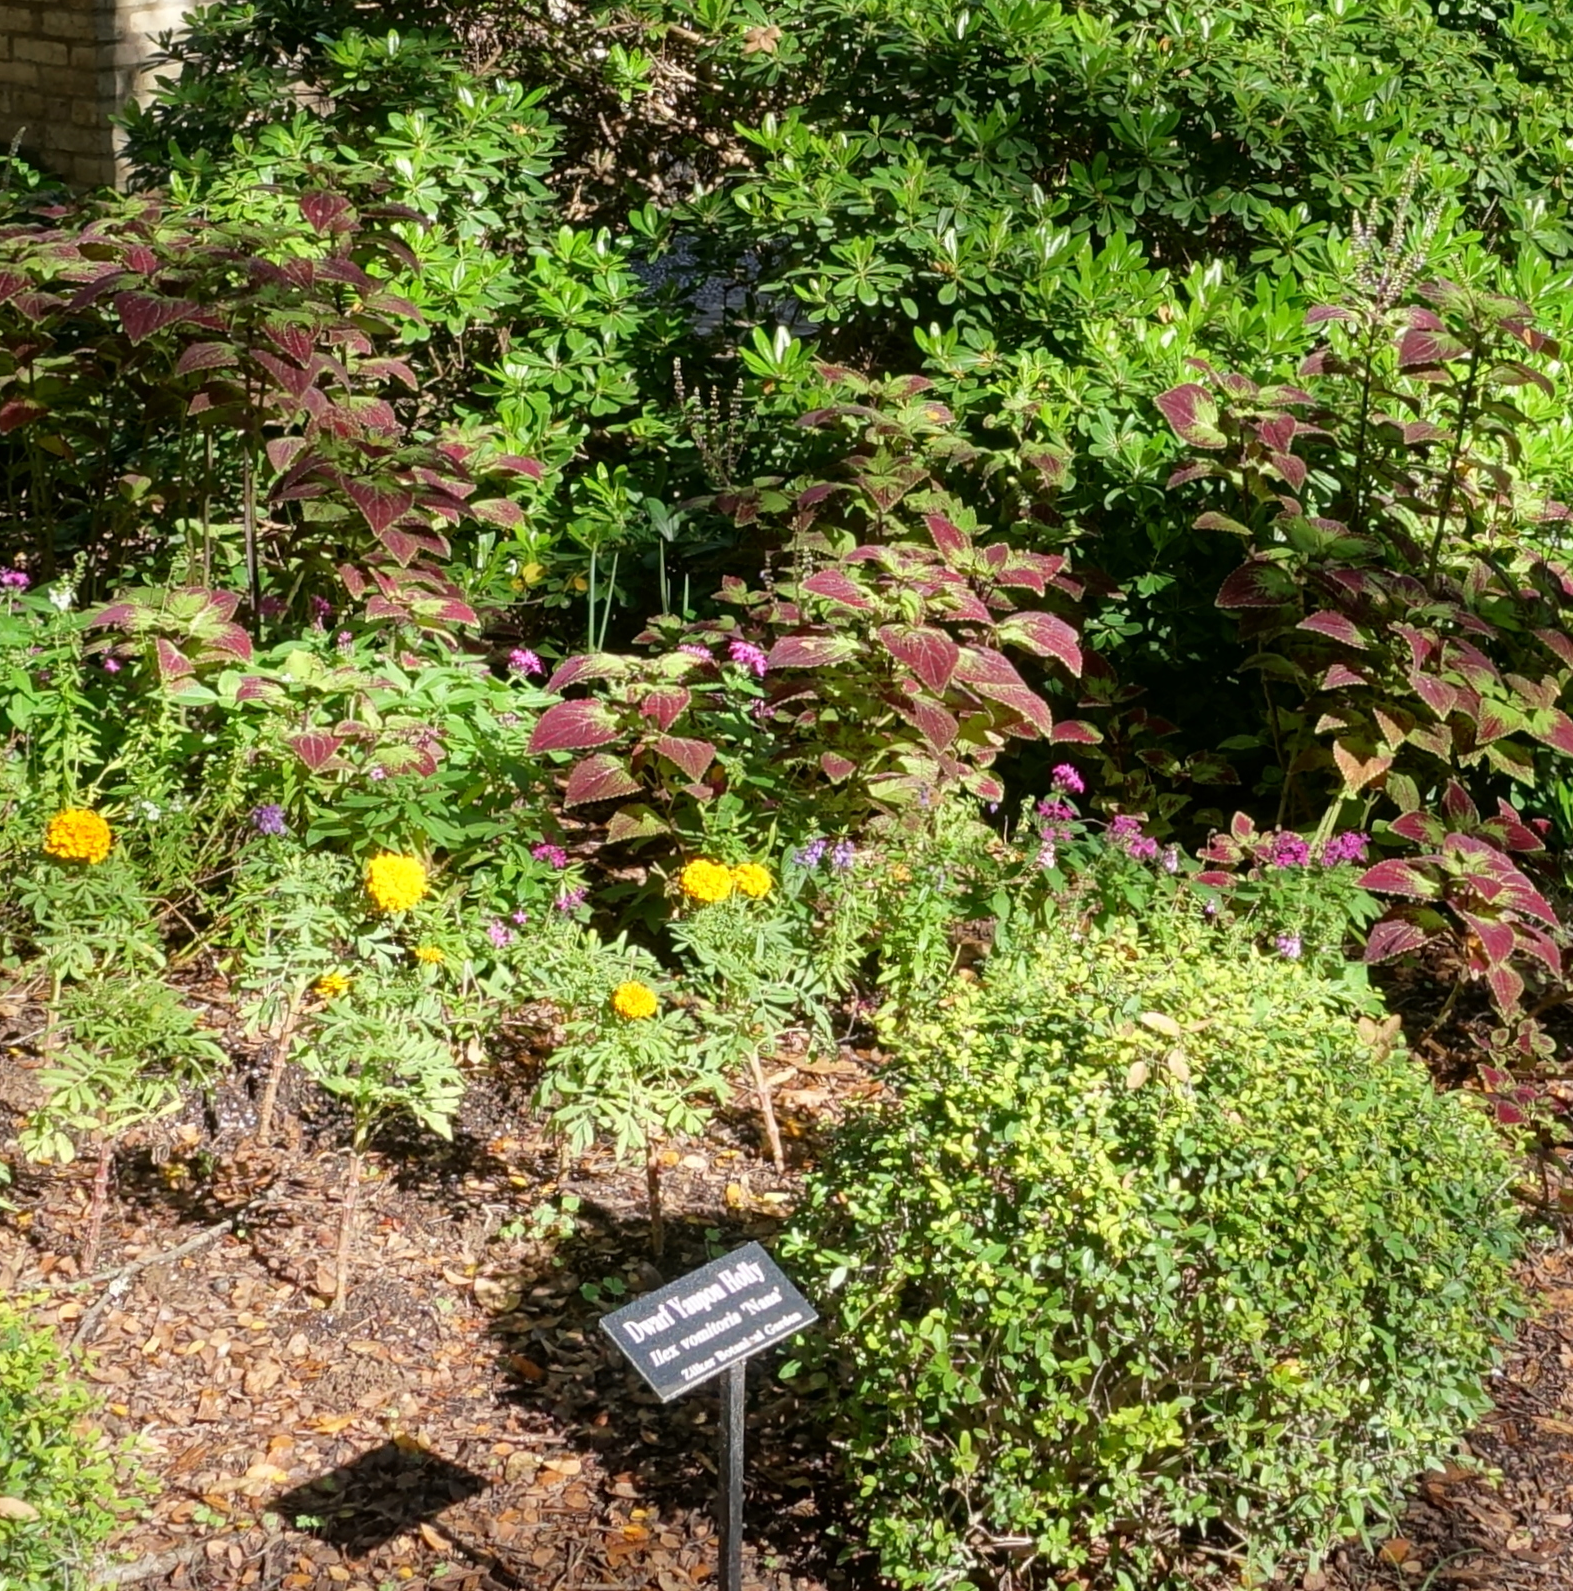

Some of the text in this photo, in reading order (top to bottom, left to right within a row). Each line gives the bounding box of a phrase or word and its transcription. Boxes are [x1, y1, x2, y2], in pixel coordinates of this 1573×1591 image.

[623, 1260, 765, 1344] Dwarf Yaupon Holly
[649, 1342, 680, 1367] Ilex
[680, 1312, 742, 1350] vomitoria
[681, 1357, 716, 1381] Zilker
[765, 1311, 803, 1336] Garden
